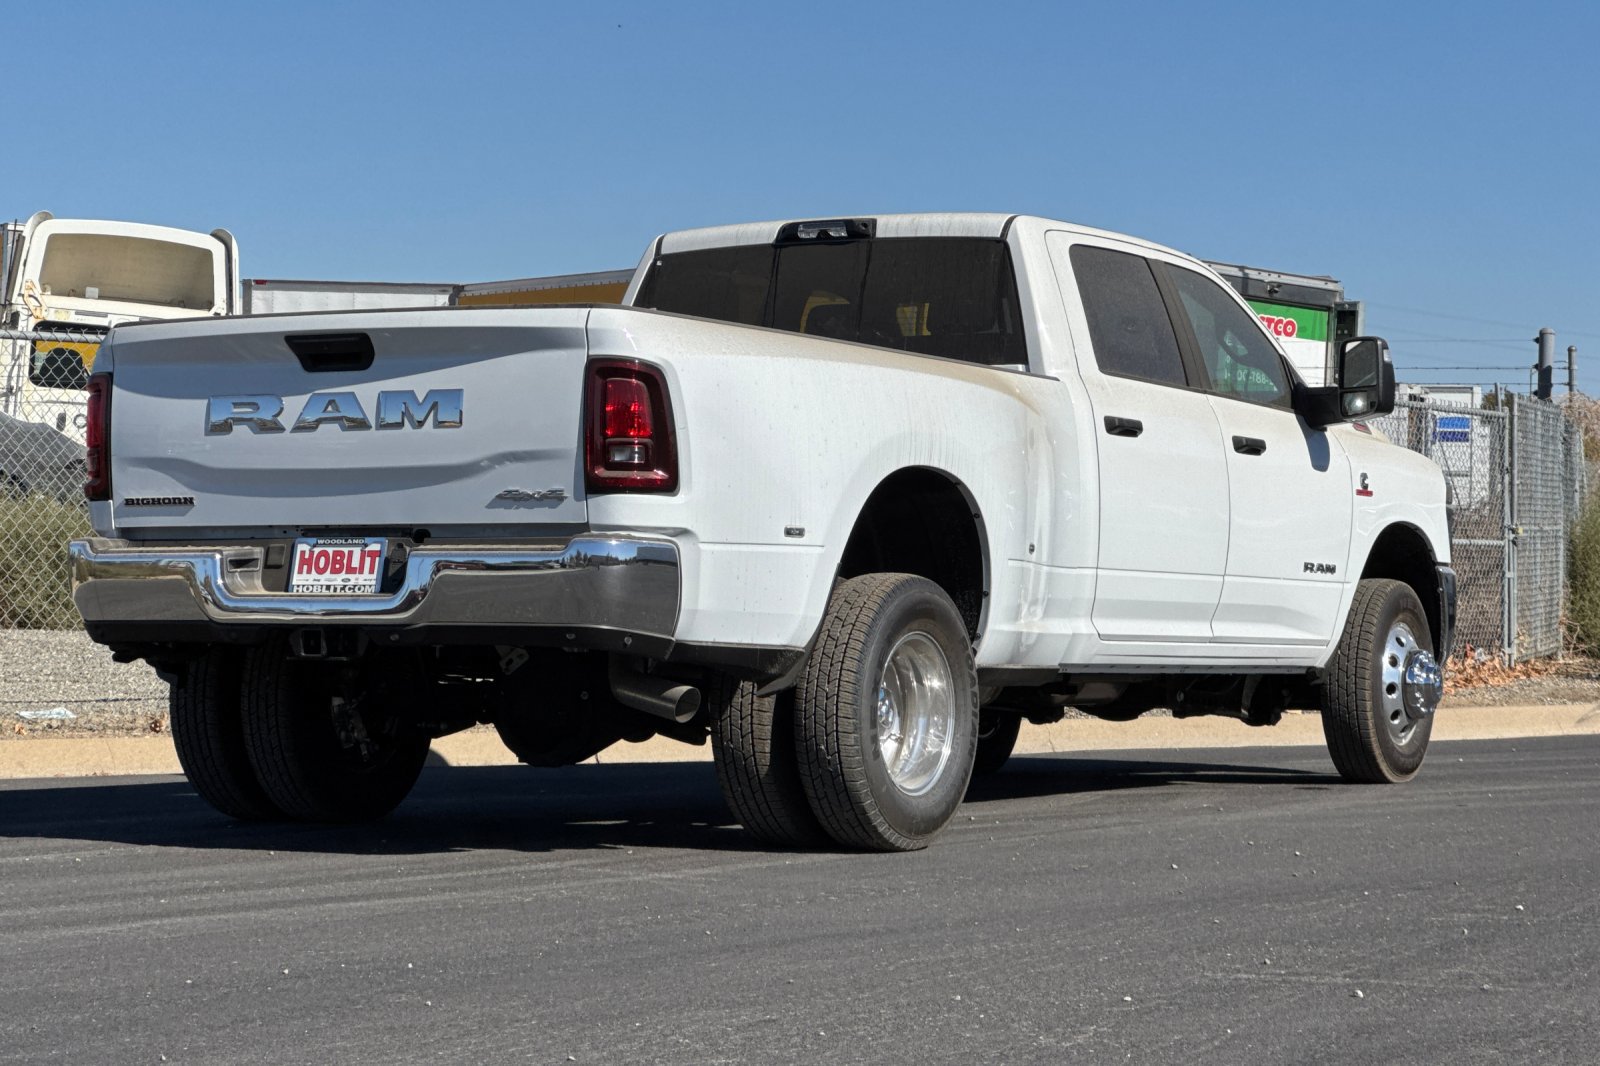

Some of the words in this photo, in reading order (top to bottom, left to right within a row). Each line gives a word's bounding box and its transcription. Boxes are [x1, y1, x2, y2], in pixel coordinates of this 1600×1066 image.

[204, 389, 464, 436] RAM
[124, 496, 195, 506] BIGHORN
[297, 549, 381, 575] HOBLIT
[1303, 561, 1337, 575] RAM
[293, 584, 376, 593] HOBLIT.COM
